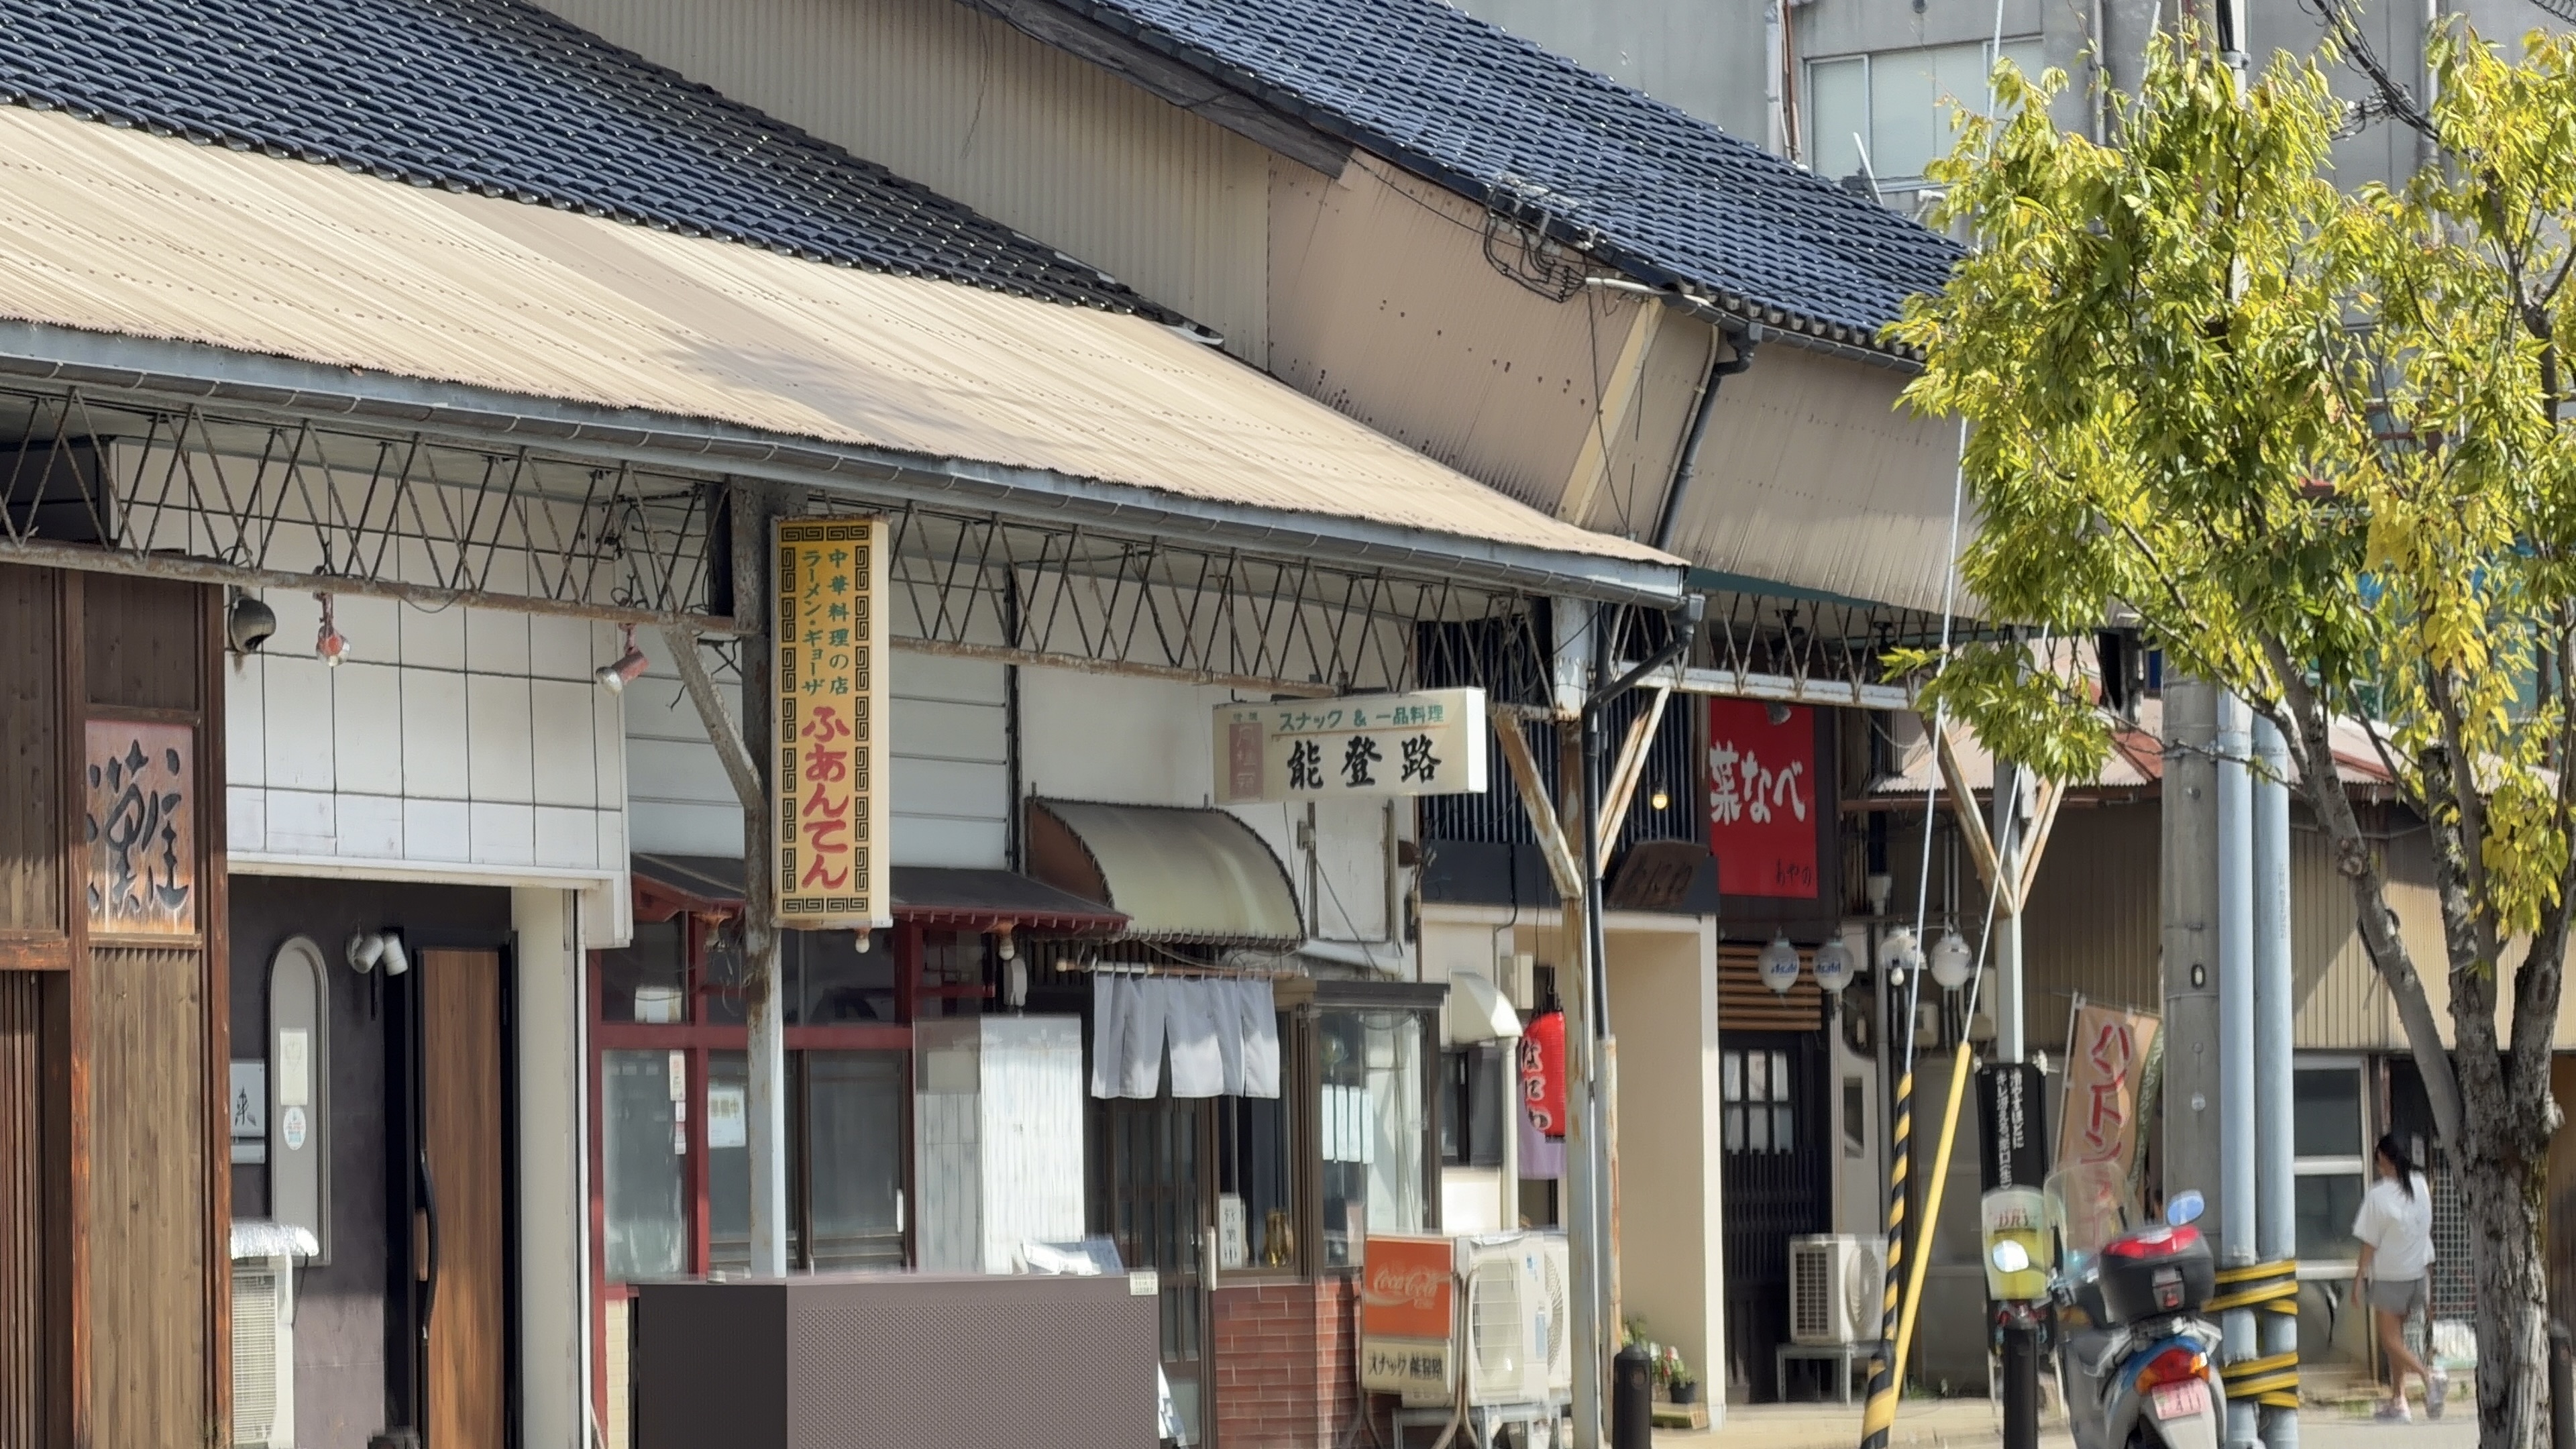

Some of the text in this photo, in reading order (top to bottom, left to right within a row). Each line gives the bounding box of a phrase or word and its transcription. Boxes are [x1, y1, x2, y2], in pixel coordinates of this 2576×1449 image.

[801, 549, 825, 696] ラーメン・ギョーザ
[827, 547, 850, 696] 中華料理の店
[1279, 710, 1343, 732] スナック
[1354, 712, 1367, 727] &
[1375, 704, 1444, 726] 一品料理
[801, 705, 850, 890] ふあんてん
[1287, 734, 1442, 790] 能登路
[1710, 739, 1806, 826] 菜なべ
[1367, 1351, 1407, 1377] スナック
